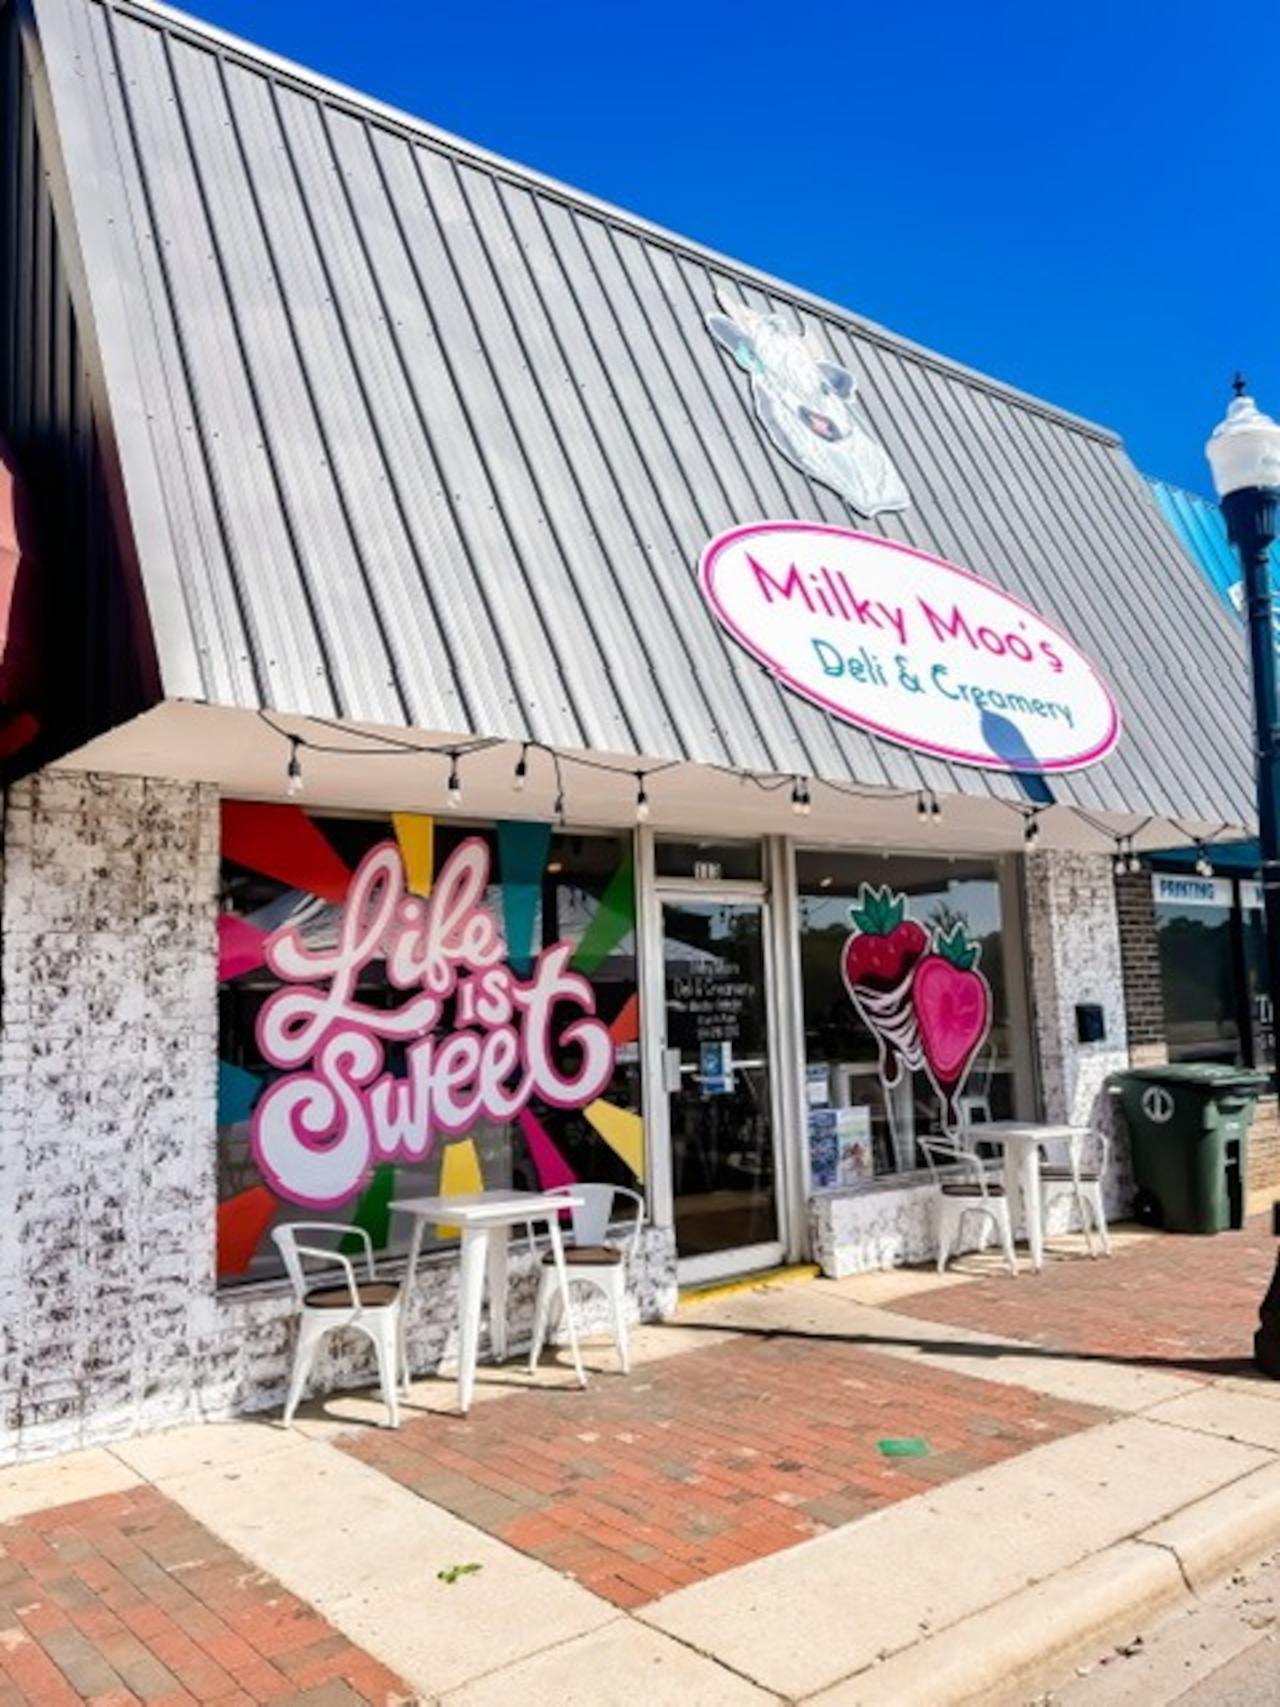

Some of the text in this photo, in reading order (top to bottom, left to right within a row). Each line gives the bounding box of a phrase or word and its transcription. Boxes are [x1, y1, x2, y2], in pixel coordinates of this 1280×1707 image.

[743, 551, 1064, 674] Milky Moo's
[812, 638, 1075, 728] Deli & Creamery
[1160, 880, 1214, 900] PRINTING
[258, 841, 505, 1062] Life
[461, 969, 512, 1023] is
[256, 943, 613, 1203] Sweet
